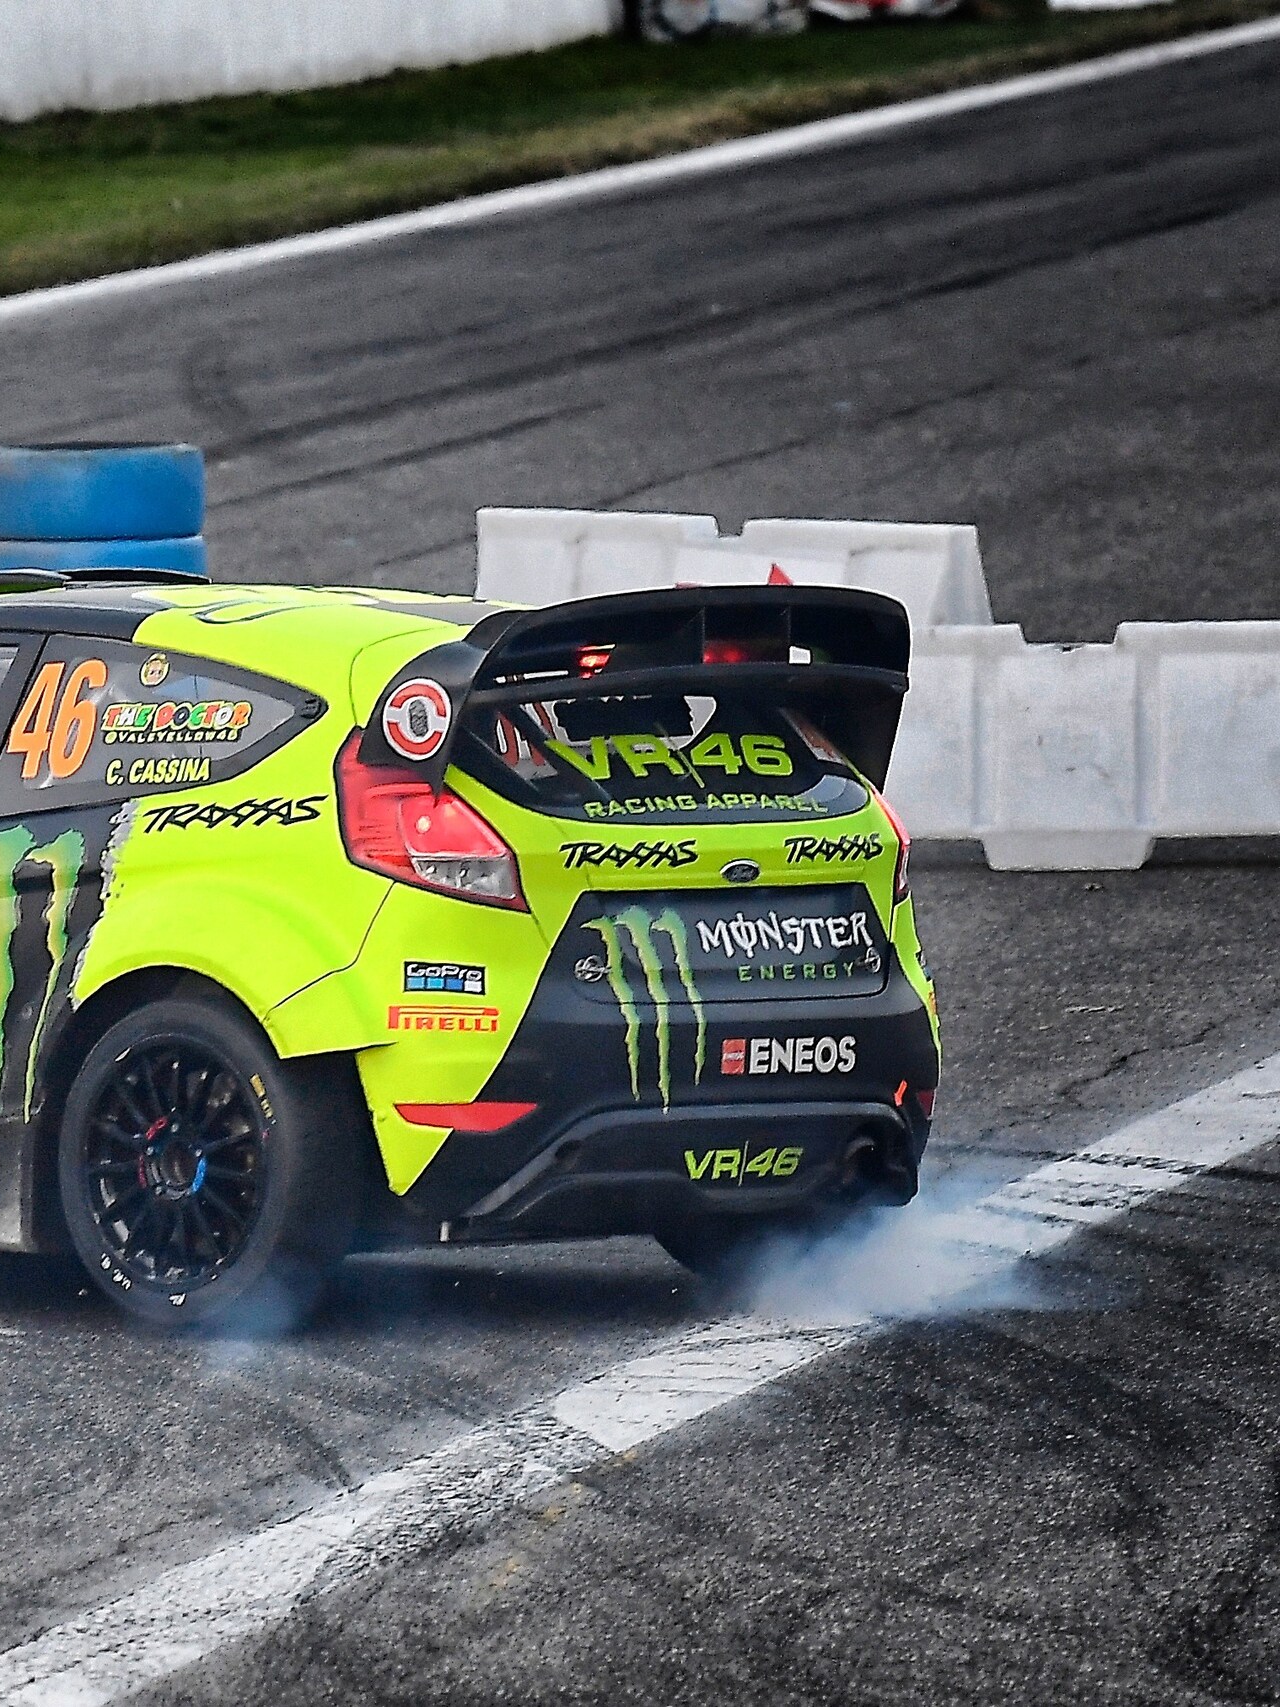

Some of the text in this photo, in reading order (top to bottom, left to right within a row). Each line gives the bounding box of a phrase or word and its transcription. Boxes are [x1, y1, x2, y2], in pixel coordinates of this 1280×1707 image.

[6, 658, 109, 780] 46
[102, 701, 251, 730] THE DOCTOR
[105, 757, 212, 786] C. CASSINA
[143, 794, 330, 834] TRAXXAS
[583, 792, 830, 818] RACING APPAREL
[559, 839, 700, 870] TRAXXAS
[784, 833, 885, 864] TRAXXAS
[405, 963, 484, 981] GoPro
[738, 962, 856, 983] ENERGY
[388, 1005, 500, 1033] PIRELLI
[749, 1036, 857, 1074] ENEOS
